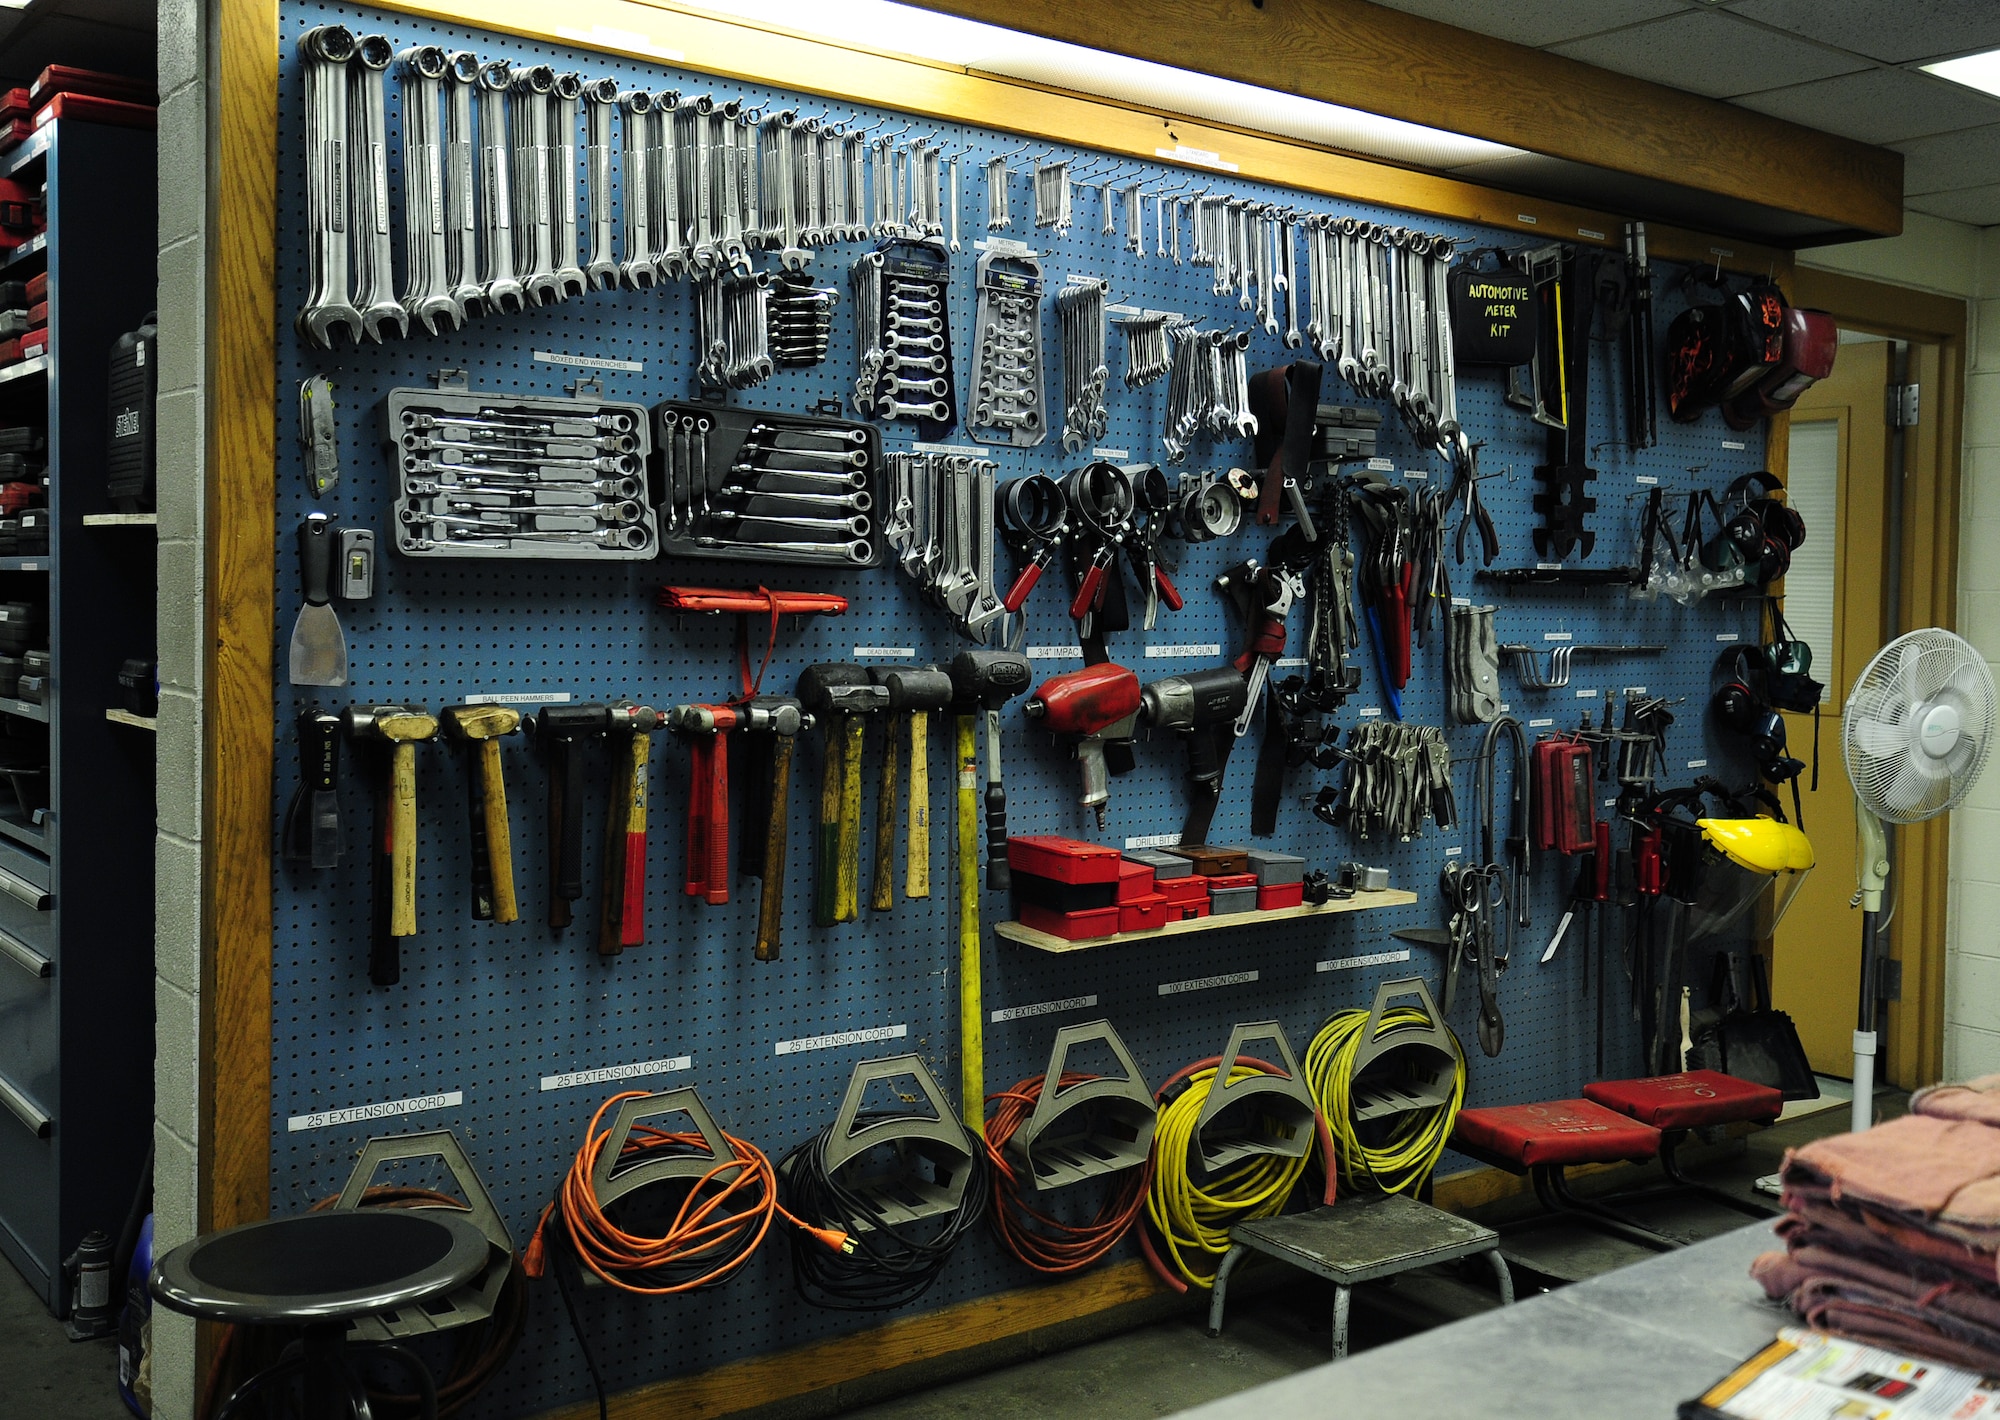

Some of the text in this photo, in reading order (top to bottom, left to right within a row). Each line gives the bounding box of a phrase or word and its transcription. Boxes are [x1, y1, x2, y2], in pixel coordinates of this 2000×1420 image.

[998, 239, 1016, 248] METRIC
[1468, 284, 1529, 301] AUTOMOTIVE
[1484, 304, 1517, 318] METER
[1490, 323, 1511, 337] KIT
[550, 355, 628, 368] BOXED END WRENCHES
[1038, 648, 1052, 656] 3/4"
[1053, 648, 1079, 656] IMPAC
[1156, 646, 1213, 656] 3/4" IMPAC GUN
[520, 694, 554, 702] HAMMERS
[1136, 834, 1182, 847] DRILL BIT SE
[1326, 952, 1401, 970] 100' EXTENSION CORD
[1169, 972, 1250, 993] 100' EXTENSION CORD
[1002, 998, 1088, 1020] 50' EXTENSION CORD
[790, 1027, 894, 1052] 25' EXTENSION CORD
[557, 1059, 676, 1087] 25' EXTENSION CORD
[308, 1095, 446, 1127] 25' EXTENSION CORD
